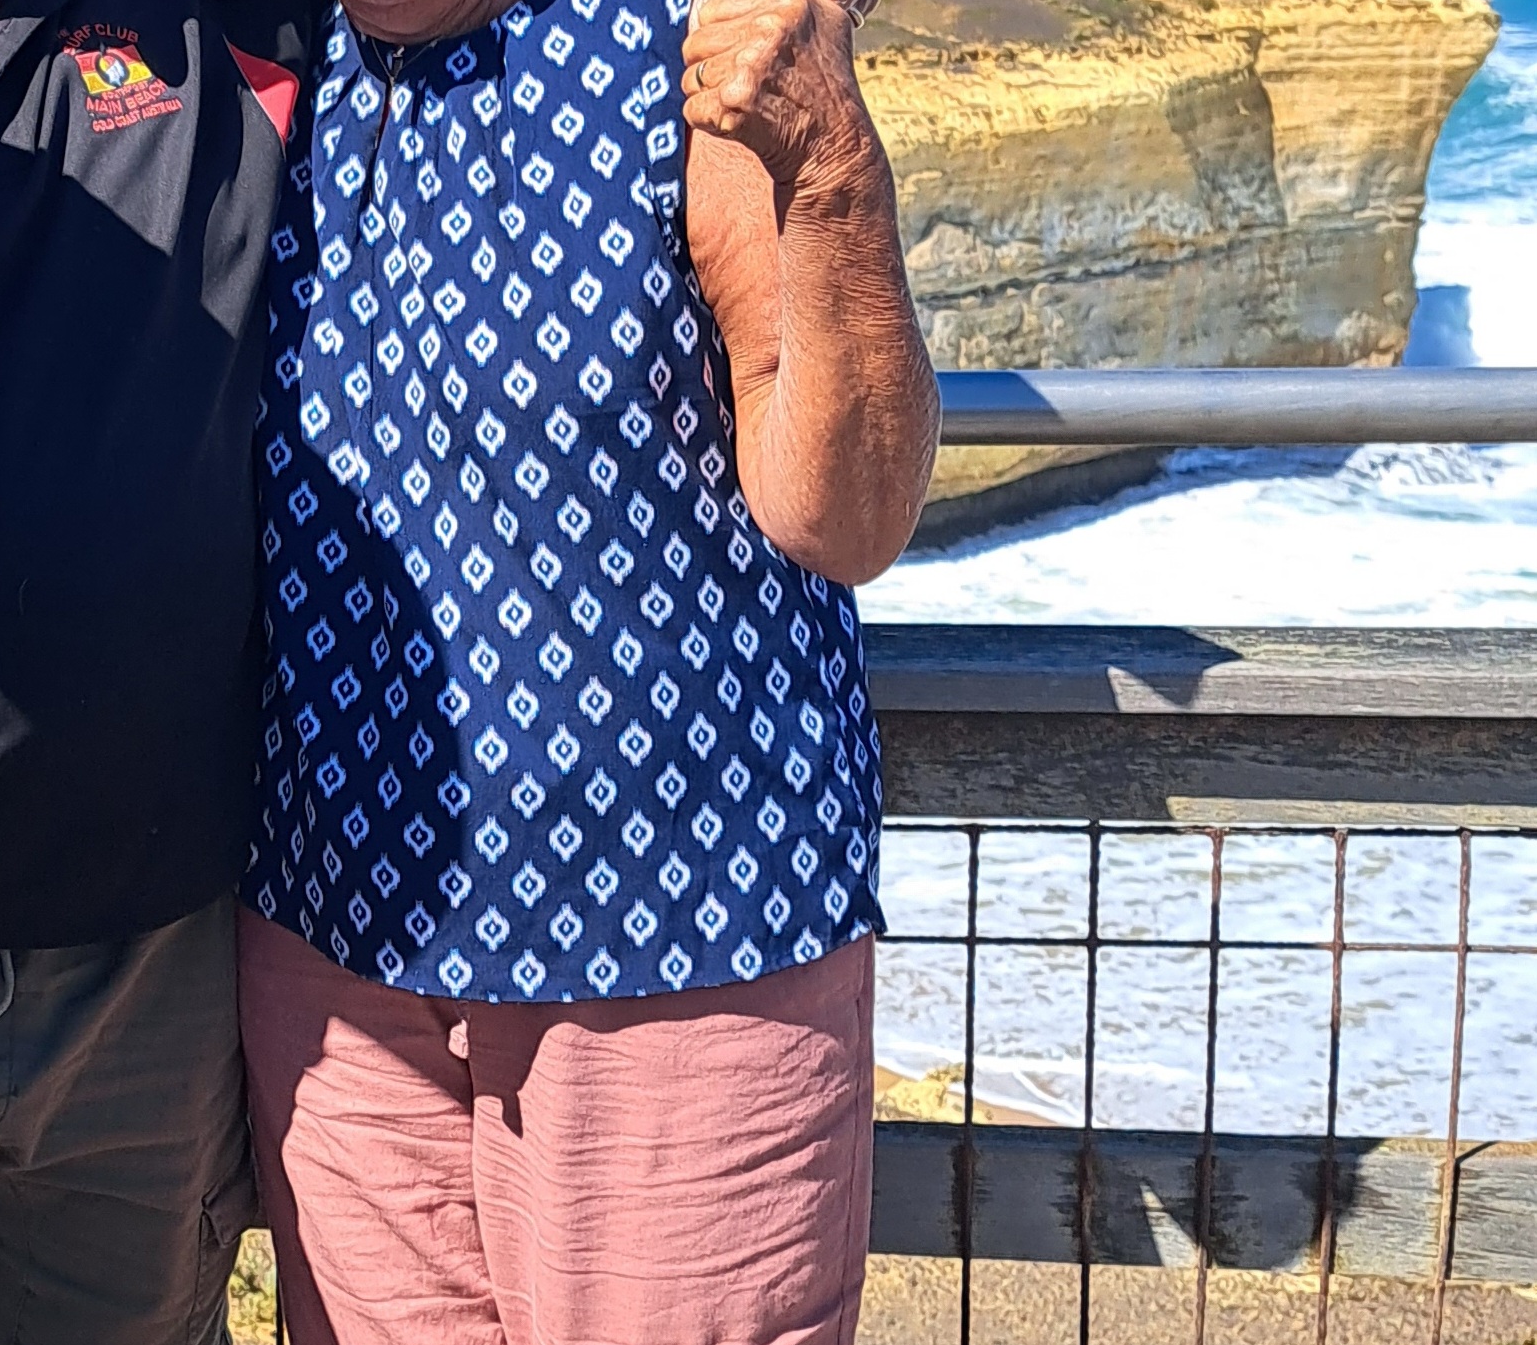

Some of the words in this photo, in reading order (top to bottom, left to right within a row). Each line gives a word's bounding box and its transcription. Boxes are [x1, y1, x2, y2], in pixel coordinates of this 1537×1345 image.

[94, 23, 139, 43] CLUB
[86, 97, 123, 115] MAIN
[124, 78, 168, 110] BEACH
[92, 119, 115, 132] GOLD
[115, 109, 141, 128] COAST
[141, 98, 183, 120] AUSTRALIA
